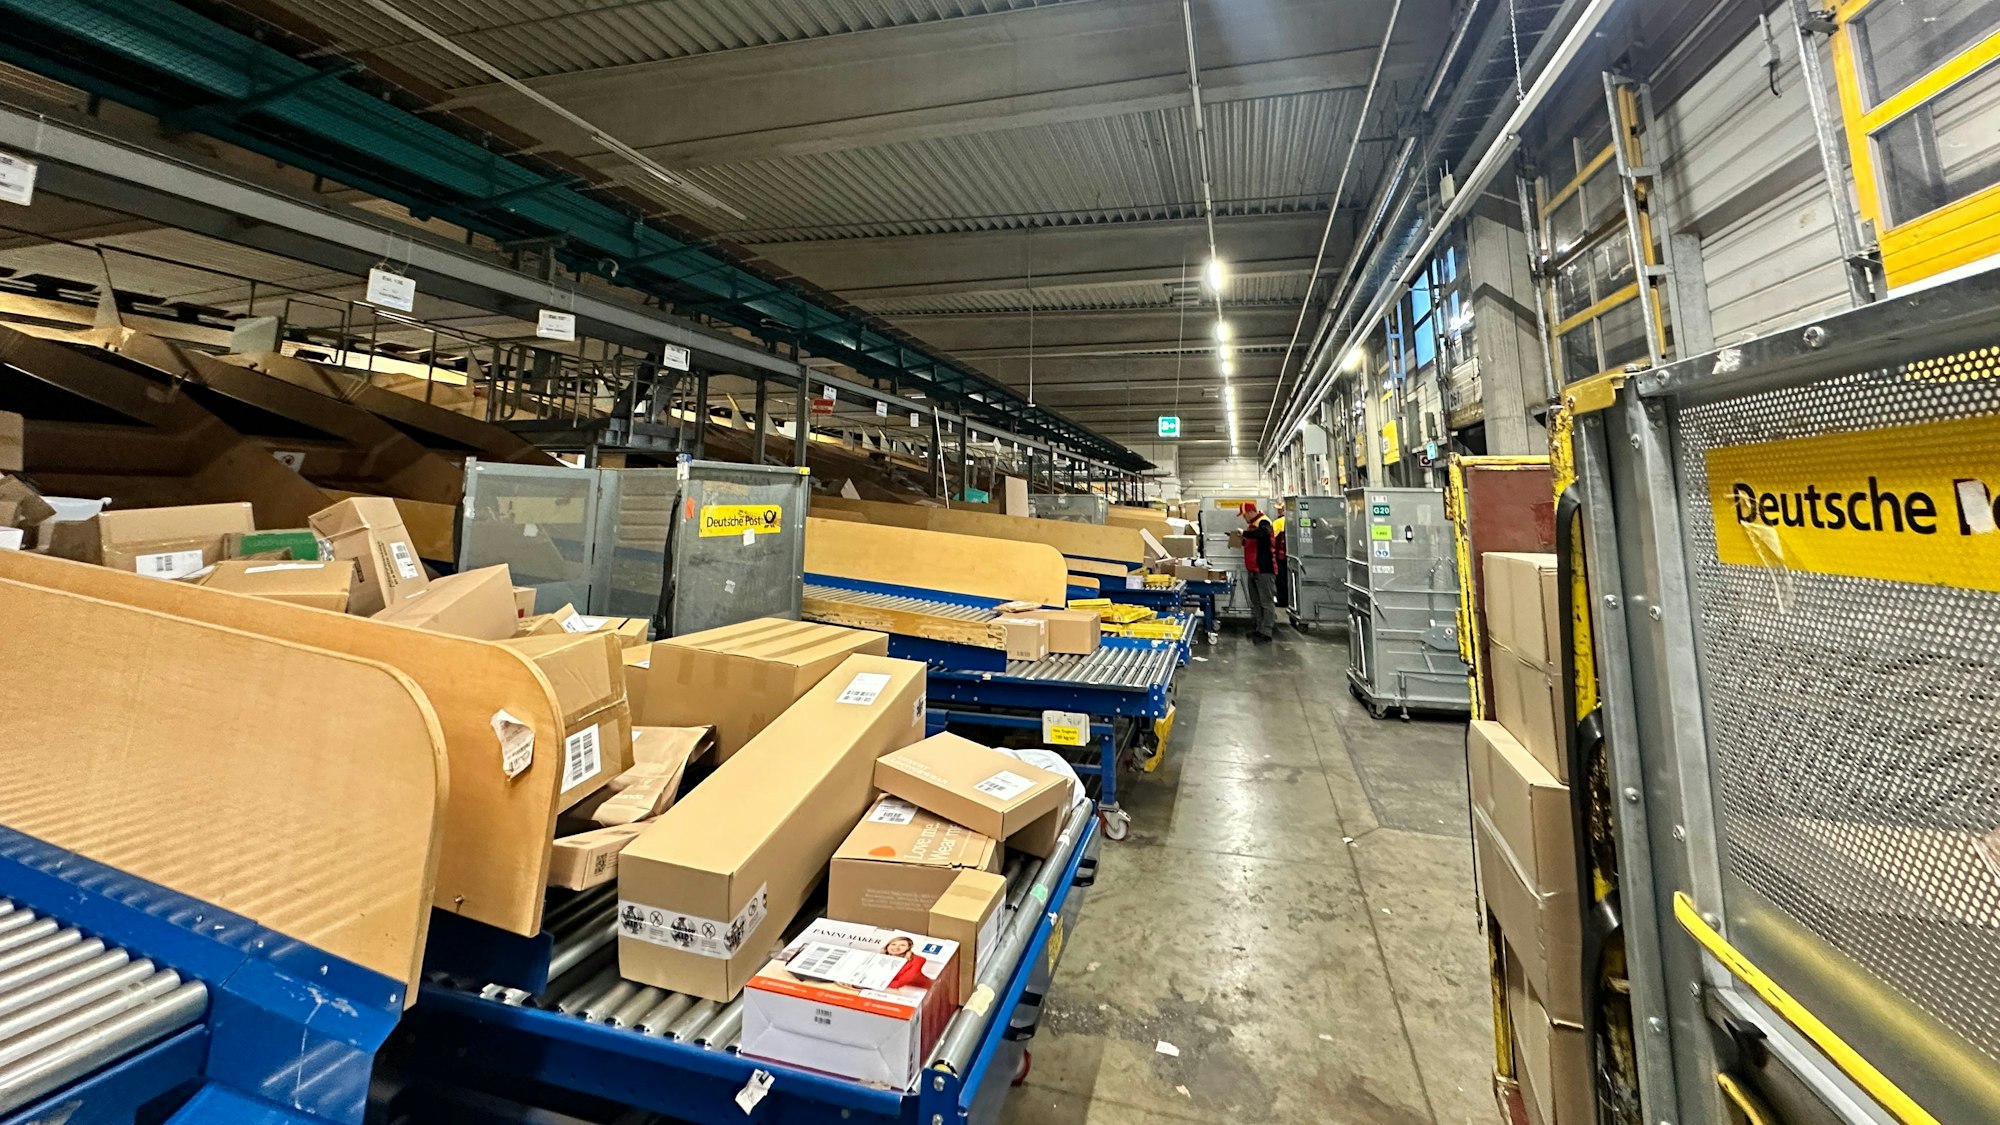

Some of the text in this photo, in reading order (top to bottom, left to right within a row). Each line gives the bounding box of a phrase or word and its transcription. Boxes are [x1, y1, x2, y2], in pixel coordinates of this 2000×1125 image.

[1373, 506, 1390, 515] G20
[1732, 476, 1937, 535] Deutsche
[706, 514, 761, 528] Deutsche Post
[903, 836, 932, 860] Love
[928, 836, 957, 861] Wear
[812, 928, 882, 945] PANINI MAKER
